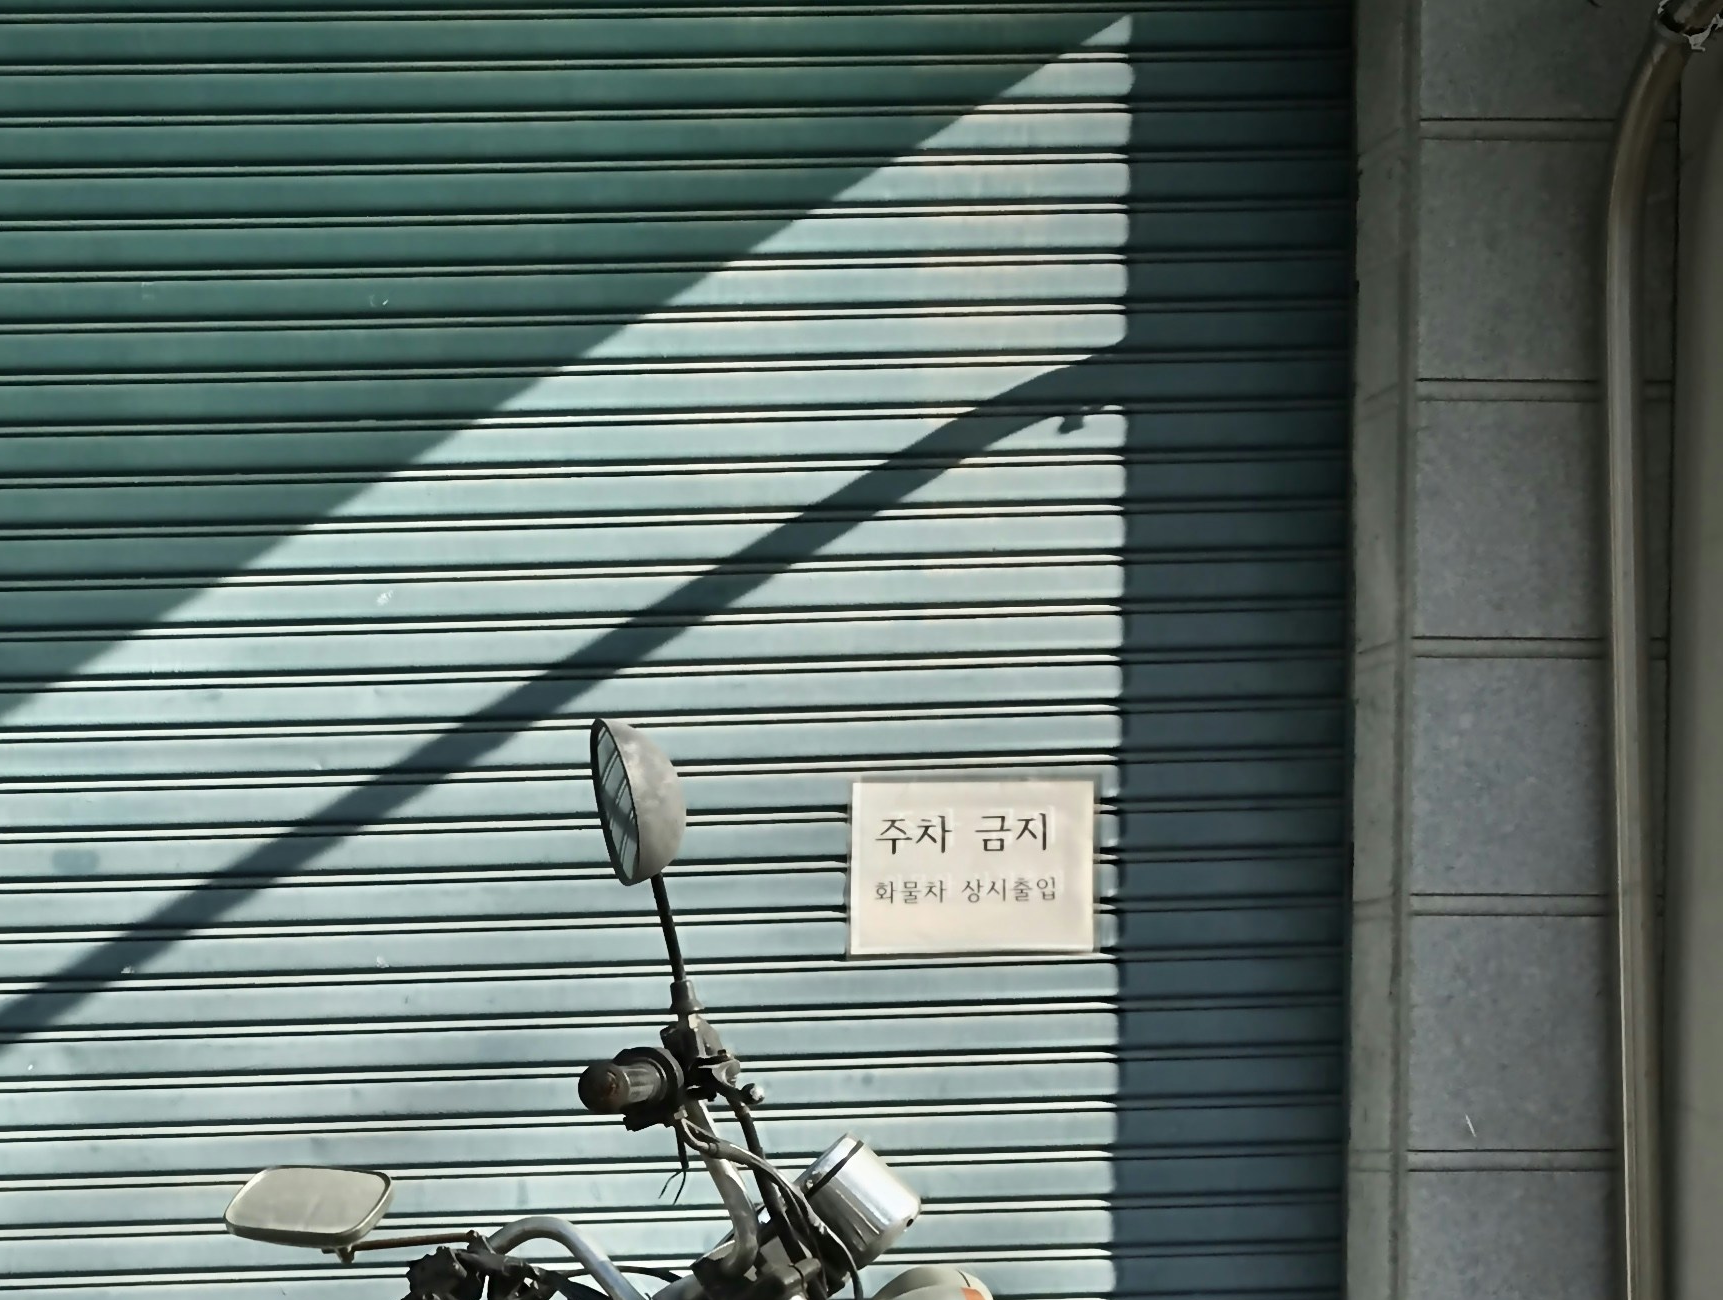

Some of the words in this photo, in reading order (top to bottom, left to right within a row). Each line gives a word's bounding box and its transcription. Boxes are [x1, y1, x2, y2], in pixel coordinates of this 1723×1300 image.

[875, 815, 953, 855] 주차
[974, 813, 1048, 852] 금지
[875, 880, 947, 904] 화물차
[962, 877, 1057, 903] 상시출입
